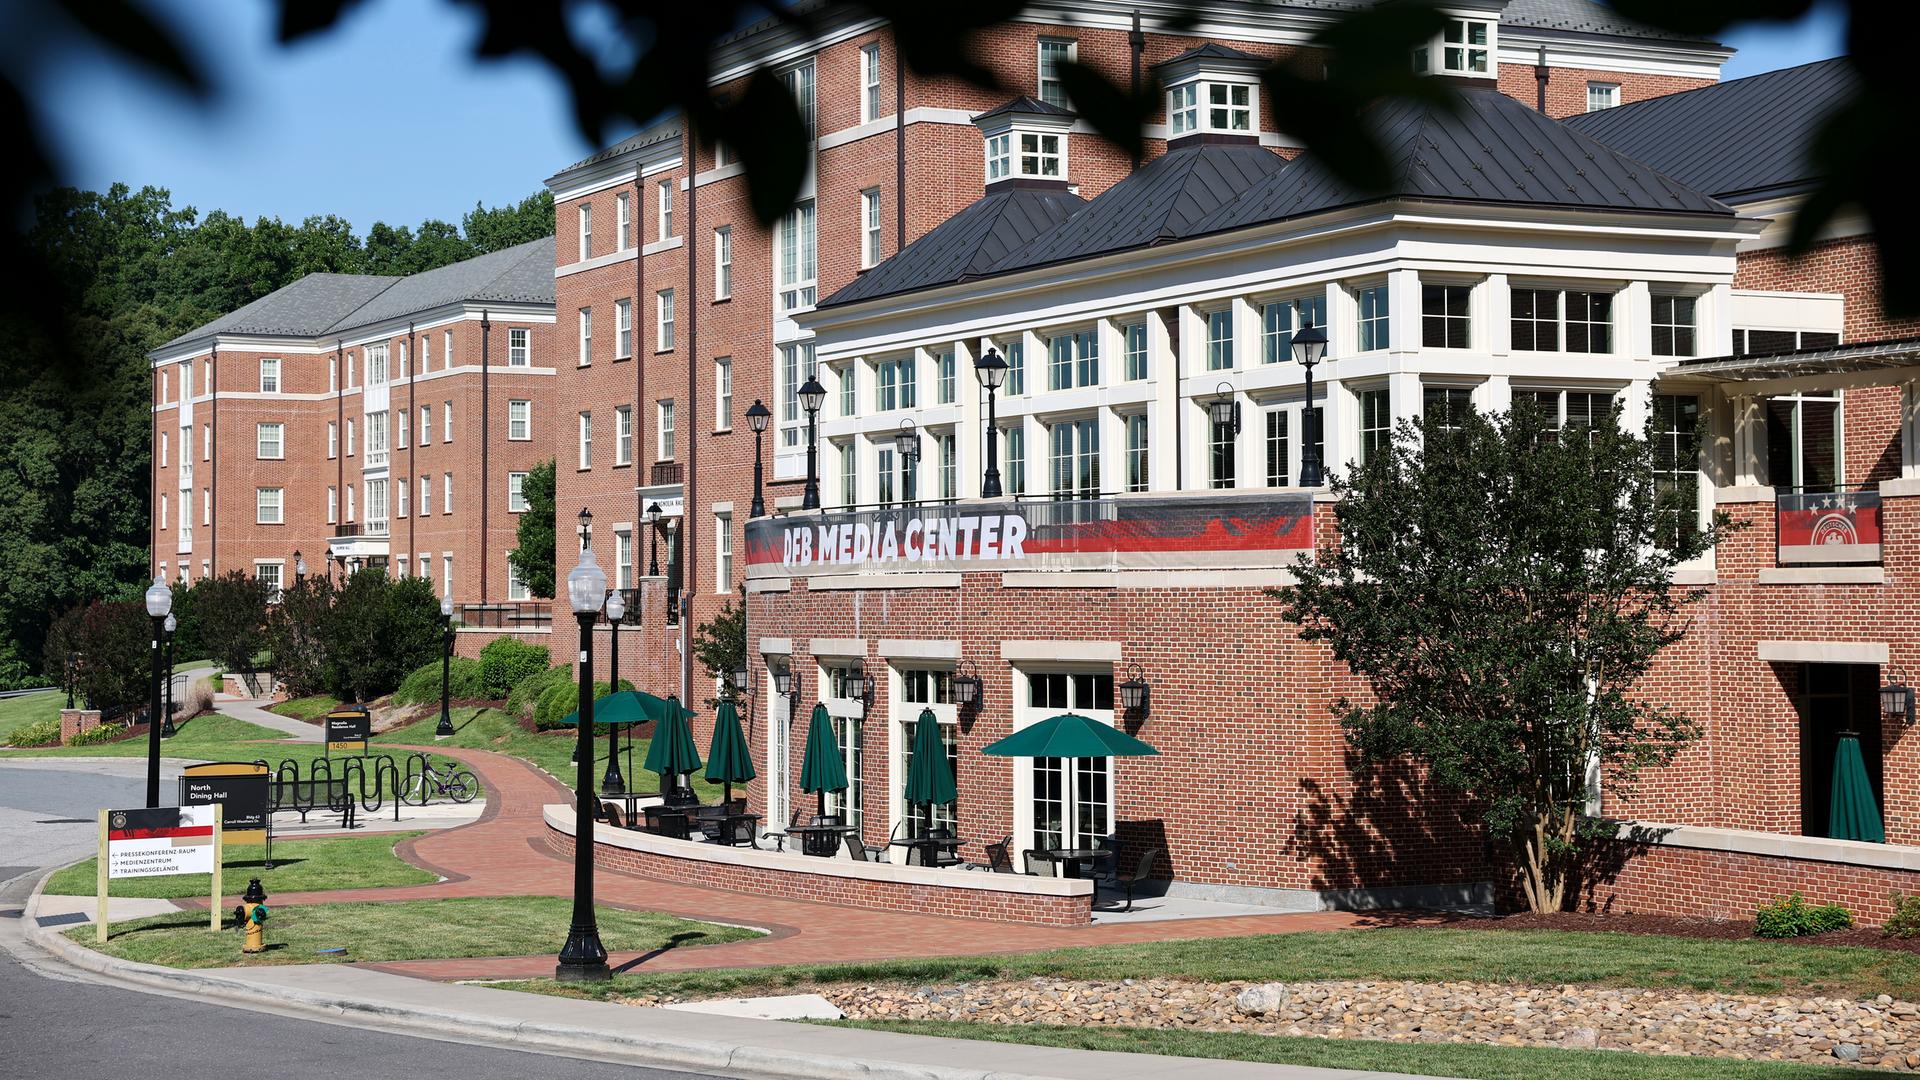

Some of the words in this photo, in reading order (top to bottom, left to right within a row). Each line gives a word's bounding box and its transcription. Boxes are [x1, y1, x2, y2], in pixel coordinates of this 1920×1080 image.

[1820, 521, 1848, 535] DEUTSCHER
[783, 527, 813, 568] DFB
[818, 520, 899, 566] MEDIA
[903, 514, 1027, 562] CENTER
[120, 858, 172, 866] MEDIENZENTRUM
[120, 865, 179, 874] TRAININGSGELÄNDE
